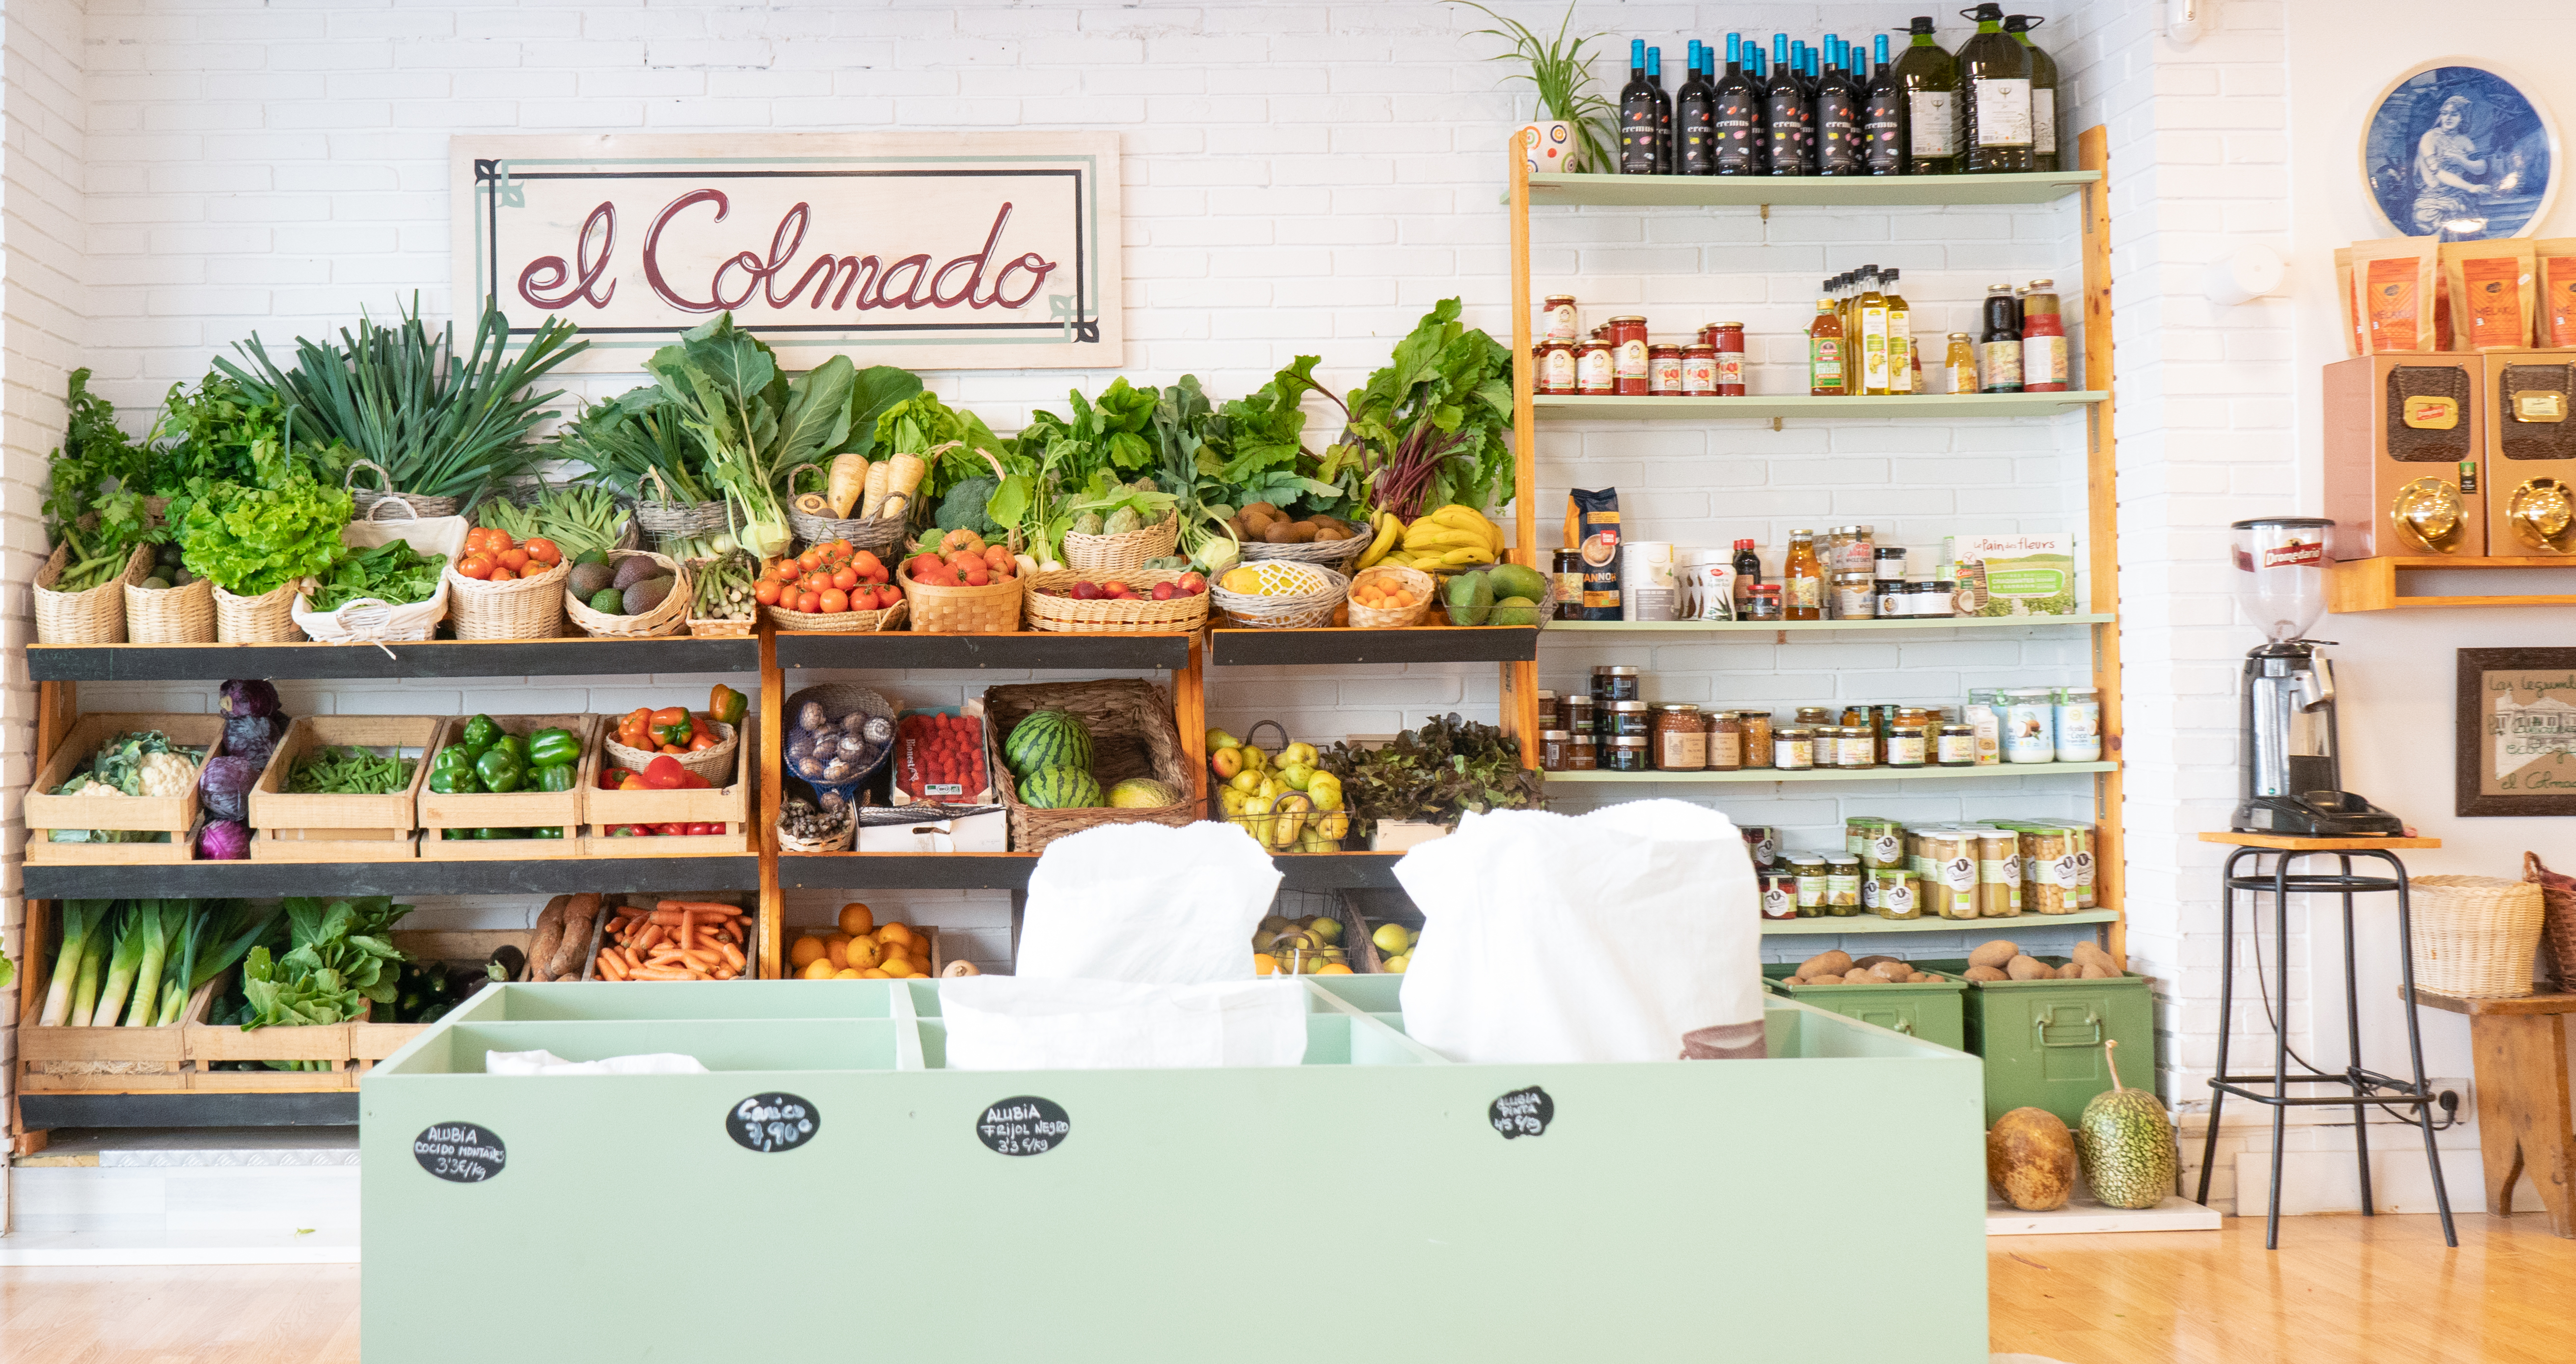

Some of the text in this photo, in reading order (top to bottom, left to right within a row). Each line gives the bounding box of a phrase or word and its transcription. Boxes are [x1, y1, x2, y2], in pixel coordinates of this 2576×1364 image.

[518, 188, 1056, 312] el Colmado
[1982, 538, 2005, 551] Pain
[2018, 537, 2056, 550] fleurs
[1583, 573, 1616, 582] ANNOH
[906, 738, 916, 767] Bionest
[414, 1142, 455, 1154] COCIDO
